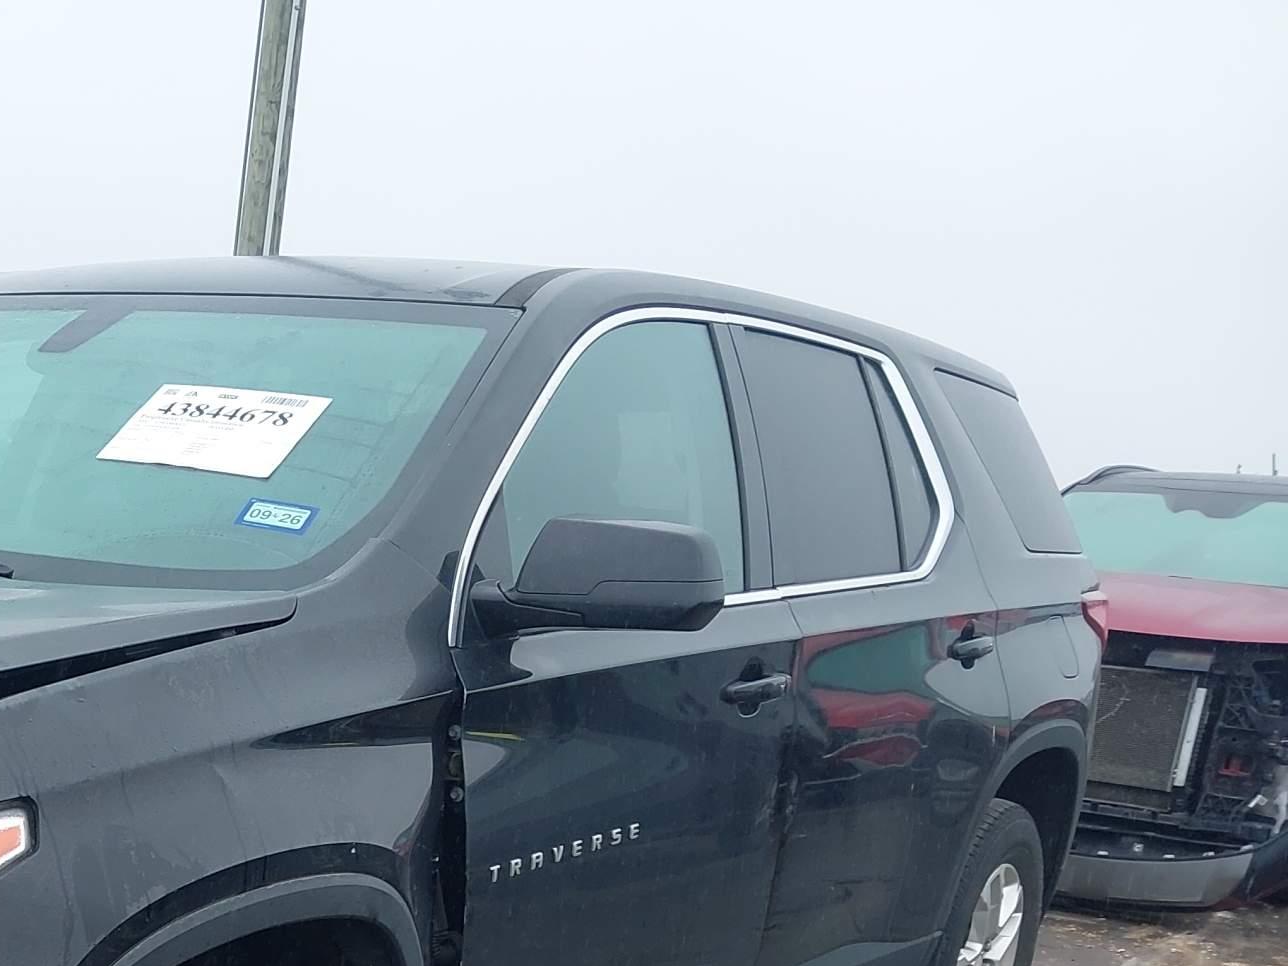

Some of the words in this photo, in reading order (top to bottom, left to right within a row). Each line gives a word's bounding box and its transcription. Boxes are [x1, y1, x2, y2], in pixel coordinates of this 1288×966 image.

[158, 401, 294, 427] 43844678
[249, 508, 272, 521] 09
[278, 512, 303, 525] 26
[489, 823, 640, 883] TRAVERSE
